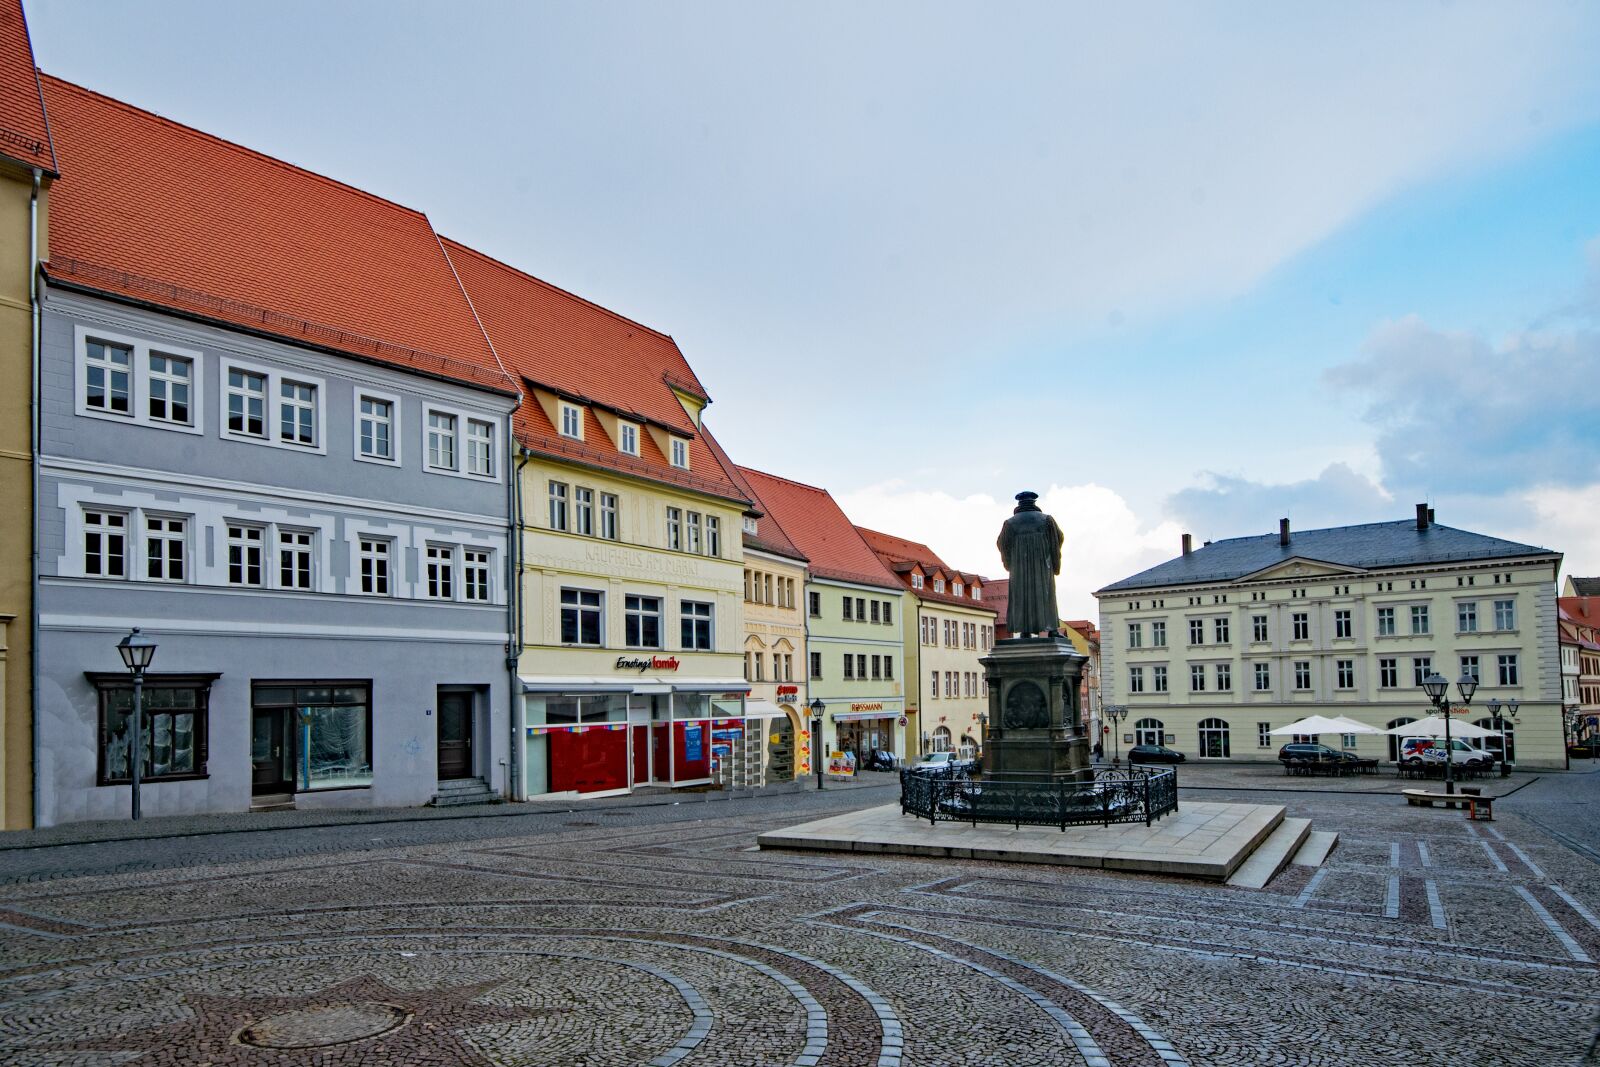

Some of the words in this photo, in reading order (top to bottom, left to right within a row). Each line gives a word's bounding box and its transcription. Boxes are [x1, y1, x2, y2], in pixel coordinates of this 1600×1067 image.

[585, 543, 643, 568] KAUFHAUS
[616, 656, 652, 672] Ernsting's
[652, 655, 680, 671] family
[851, 703, 883, 712] ROSSMANN
